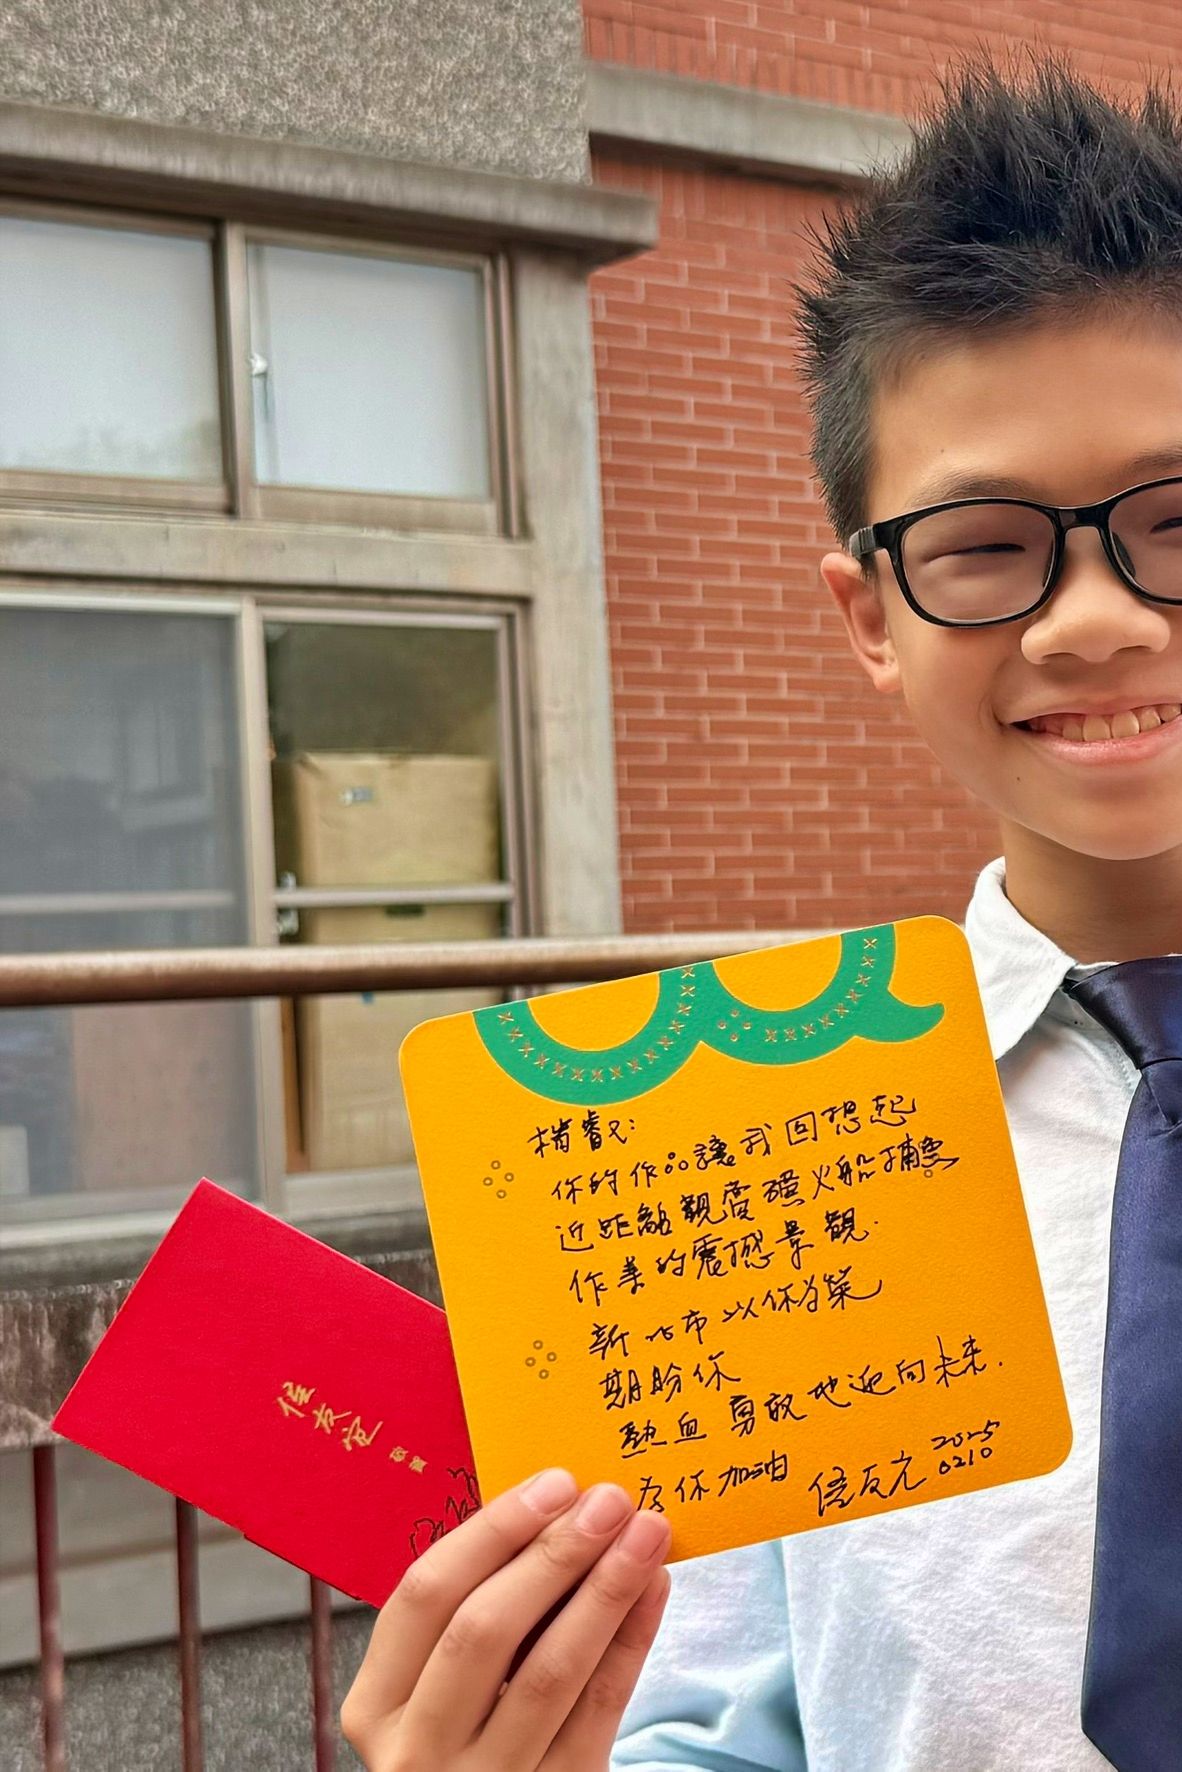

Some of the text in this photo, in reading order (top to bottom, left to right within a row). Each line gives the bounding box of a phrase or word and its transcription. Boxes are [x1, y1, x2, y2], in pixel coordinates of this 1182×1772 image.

[551, 1094, 917, 1205] 你的作品讓我回想起
[599, 1350, 742, 1411] 期盼你
[938, 1446, 994, 1476] 0210
